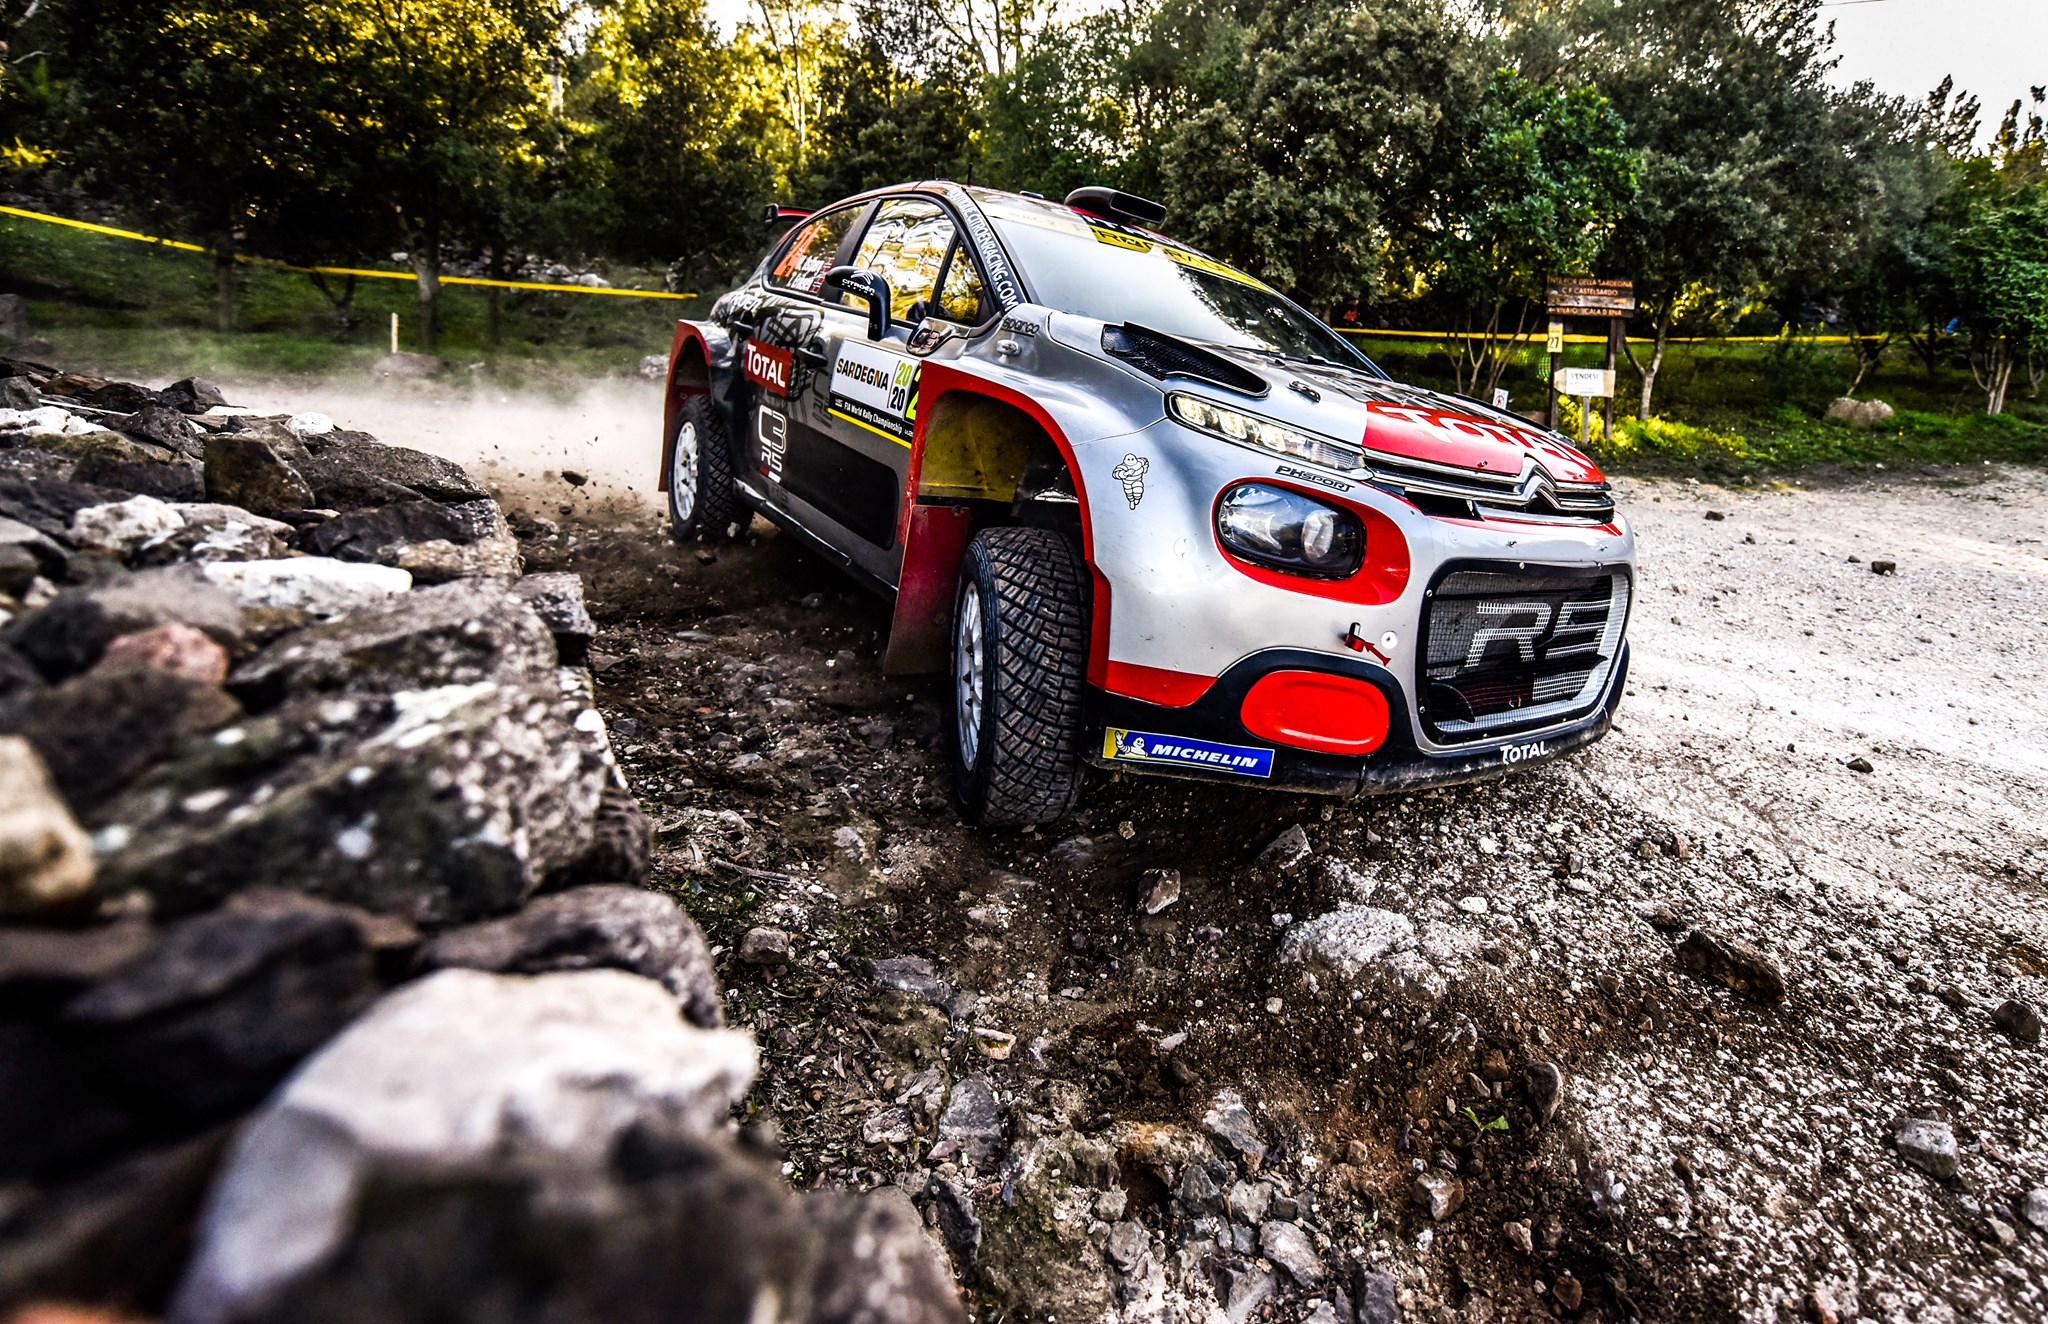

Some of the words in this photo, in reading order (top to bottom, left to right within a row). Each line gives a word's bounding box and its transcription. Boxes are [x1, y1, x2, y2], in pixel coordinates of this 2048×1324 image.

[1003, 317, 1040, 336] sparco
[747, 343, 786, 388] TOTAL
[836, 358, 889, 391] SARDEGNA
[895, 362, 913, 387] 20
[890, 386, 906, 412] 20
[1374, 405, 1598, 478] TOTAL
[1275, 465, 1355, 492] PHSPORT
[1464, 599, 1613, 668] R5
[1151, 743, 1258, 768] MICHELIN
[1500, 741, 1549, 765] TOTAL
